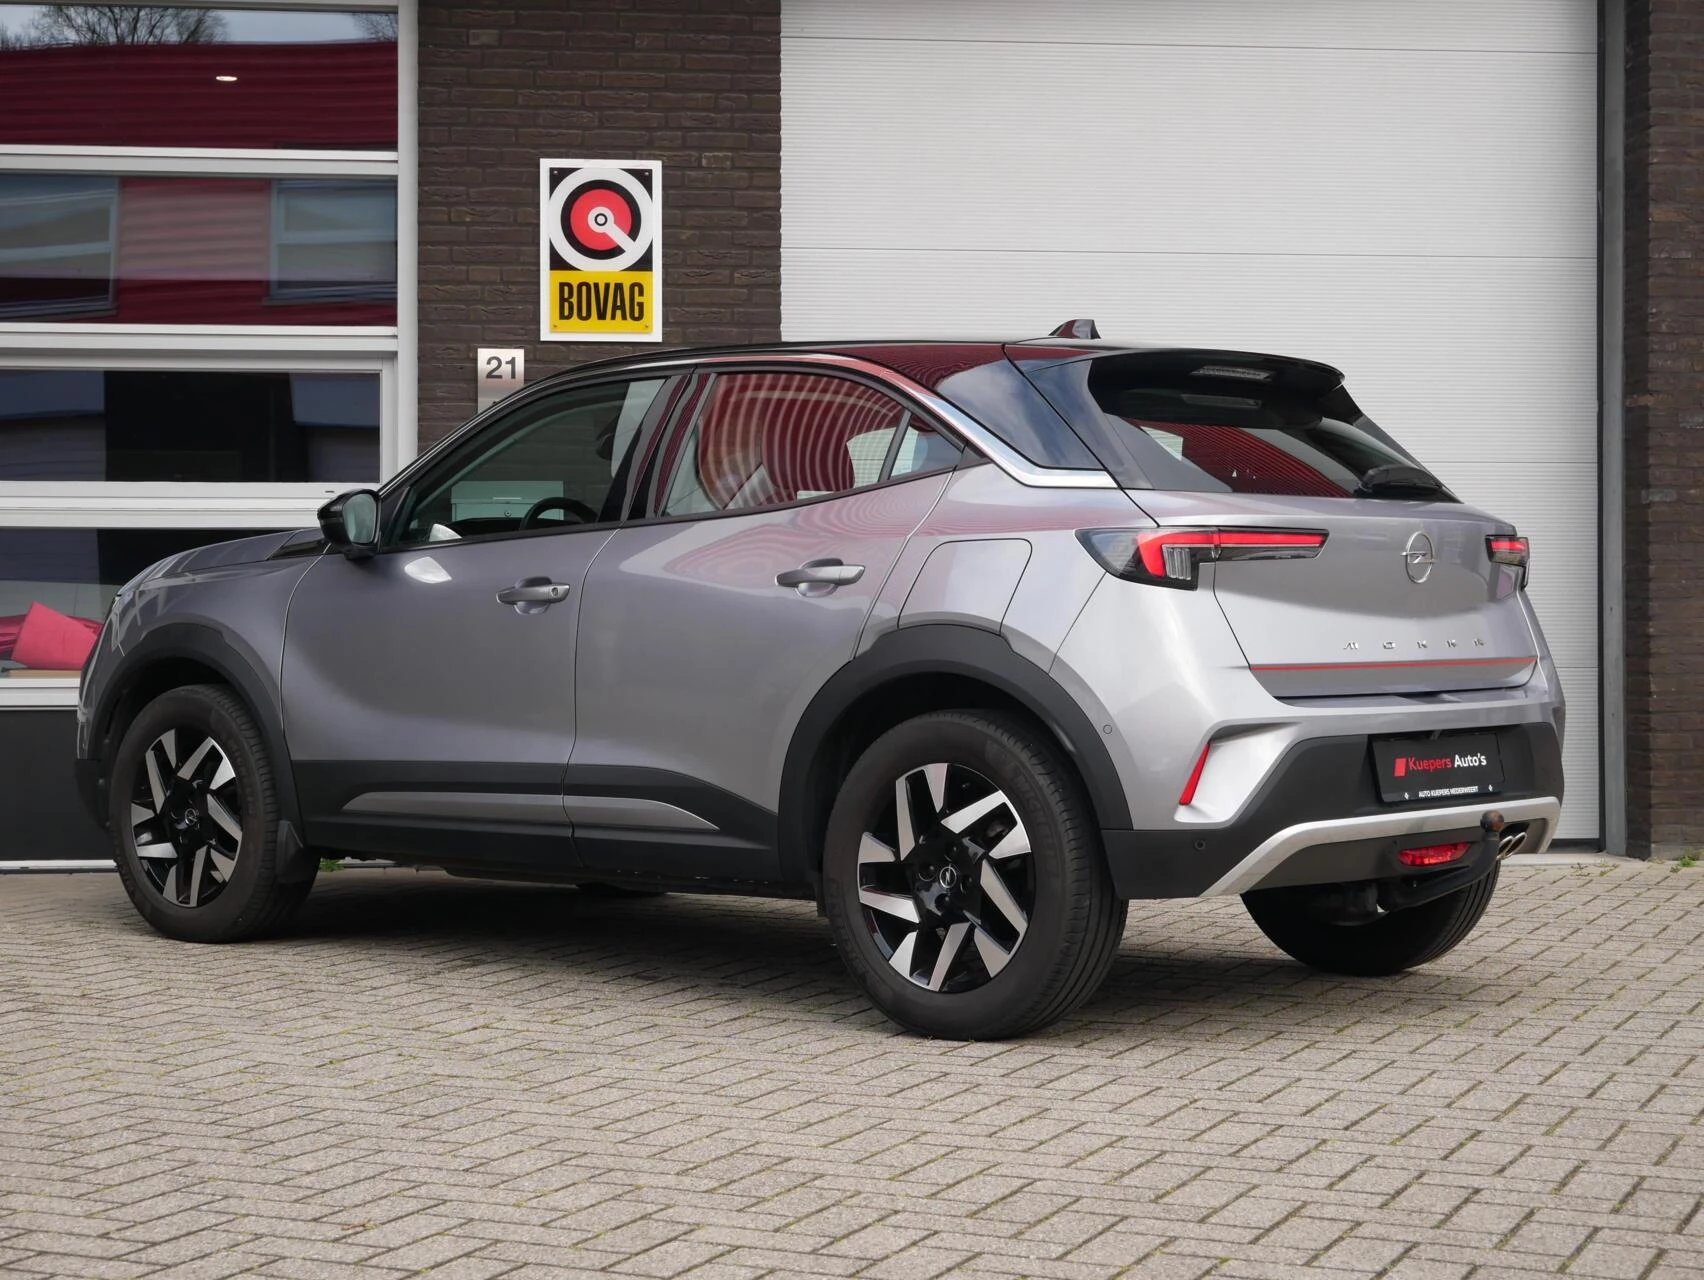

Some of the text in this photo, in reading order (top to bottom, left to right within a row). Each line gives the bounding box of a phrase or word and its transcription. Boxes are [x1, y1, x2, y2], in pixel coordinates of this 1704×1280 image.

[559, 282, 645, 321] BOVAG
[486, 356, 516, 379] 21
[1408, 753, 1487, 772] Kuepers Auto's
[1419, 790, 1431, 798] AUTO
